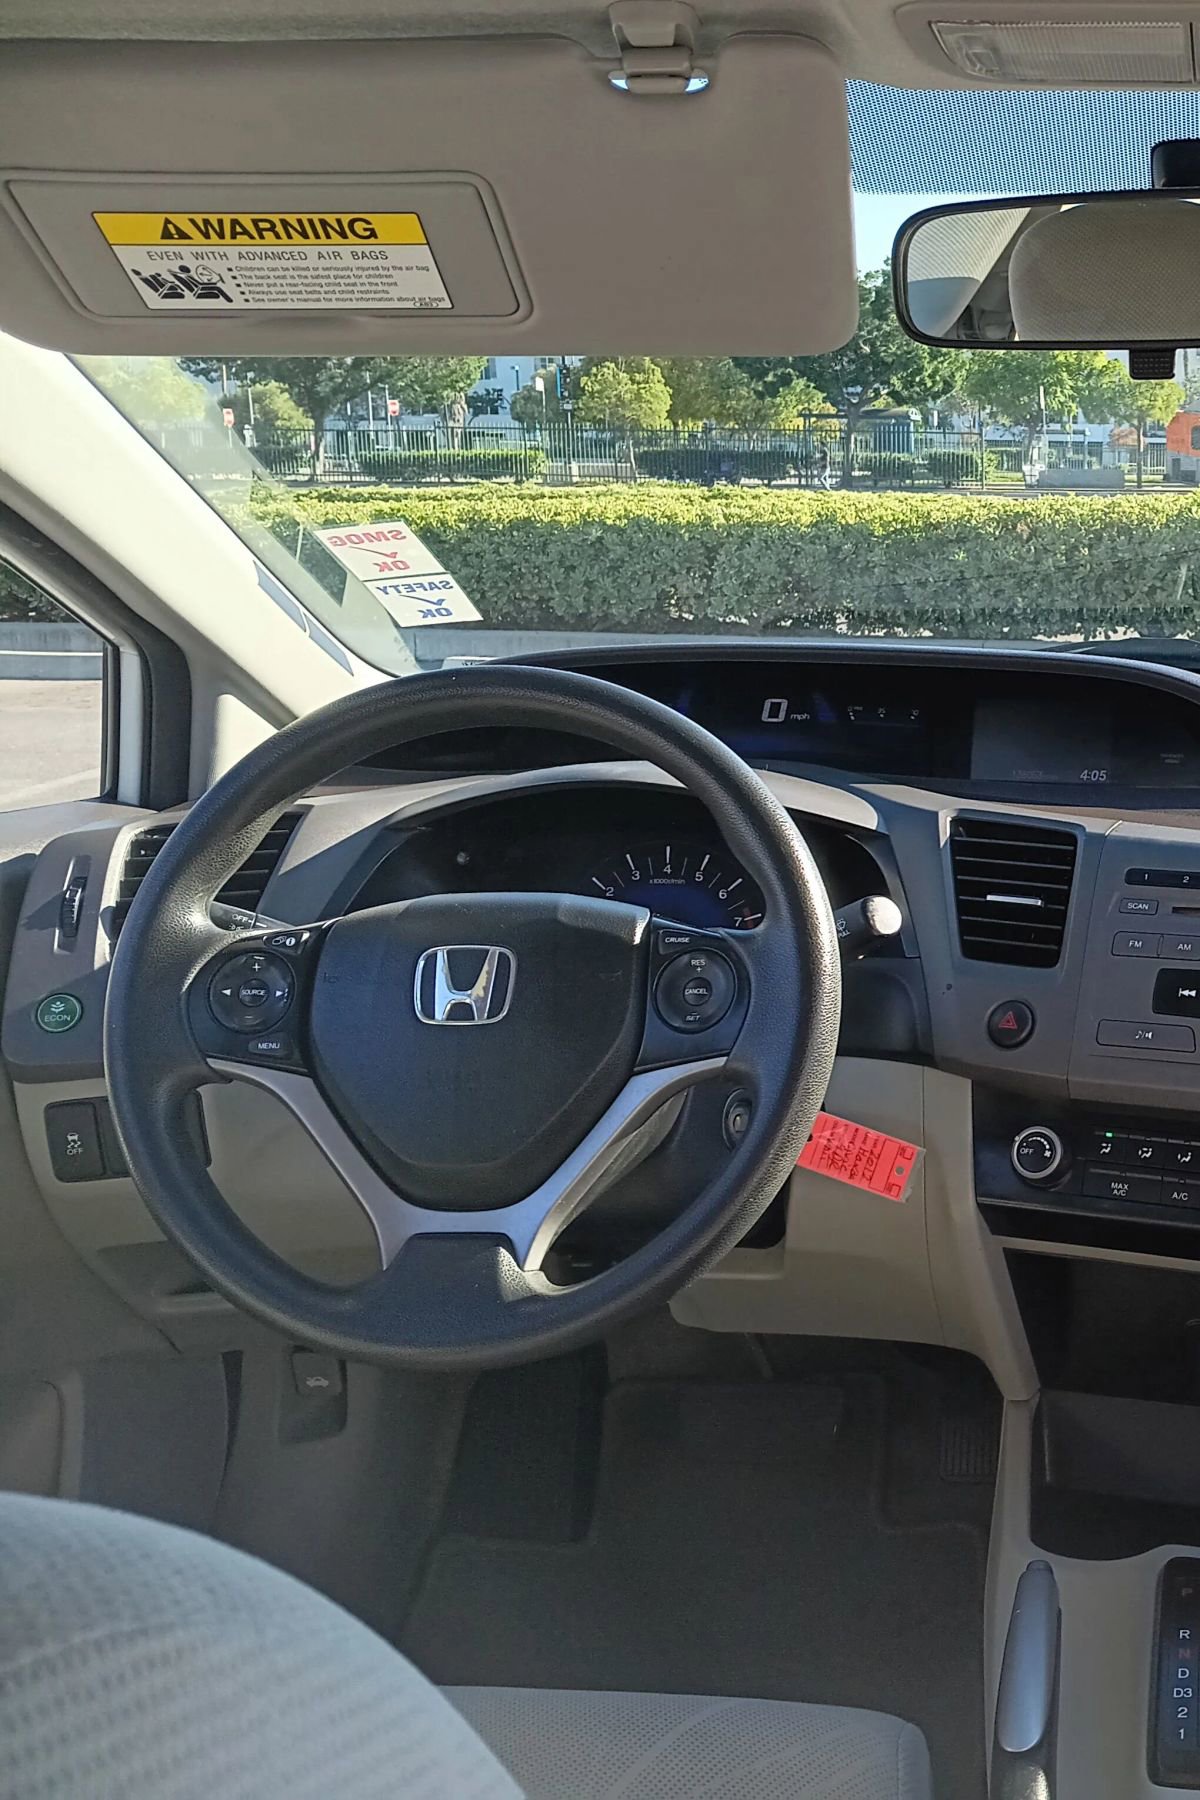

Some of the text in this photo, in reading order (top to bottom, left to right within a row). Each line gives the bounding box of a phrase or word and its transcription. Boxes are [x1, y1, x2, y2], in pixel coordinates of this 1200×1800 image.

[188, 218, 378, 240] WARNING
[148, 250, 388, 261] EVEN WITH ADVANCED AIR BAGS
[762, 699, 788, 722] 0
[1080, 769, 1107, 781] 4:05
[664, 865, 672, 874] 4
[632, 871, 640, 880] 3
[695, 872, 703, 882] 5
[1144, 873, 1149, 881] 1
[606, 887, 614, 896] 2
[719, 889, 727, 899] 6
[1127, 902, 1149, 910] SCAN
[734, 918, 742, 926] 7
[1129, 940, 1142, 948] FM
[1177, 943, 1192, 952] AM
[44, 1014, 71, 1022] ECON
[258, 1042, 280, 1050] MENU
[67, 1148, 83, 1156] OFF
[1020, 1147, 1034, 1155] OFF
[1111, 1182, 1129, 1190] MAX
[1112, 1189, 1127, 1197] A/C
[1172, 1191, 1189, 1201] A/C
[1180, 1630, 1190, 1639] R
[1178, 1649, 1189, 1658] N
[1178, 1668, 1189, 1678] D
[1173, 1688, 1192, 1698] D3
[1177, 1707, 1187, 1718] 2
[1178, 1728, 1184, 1739] 1
